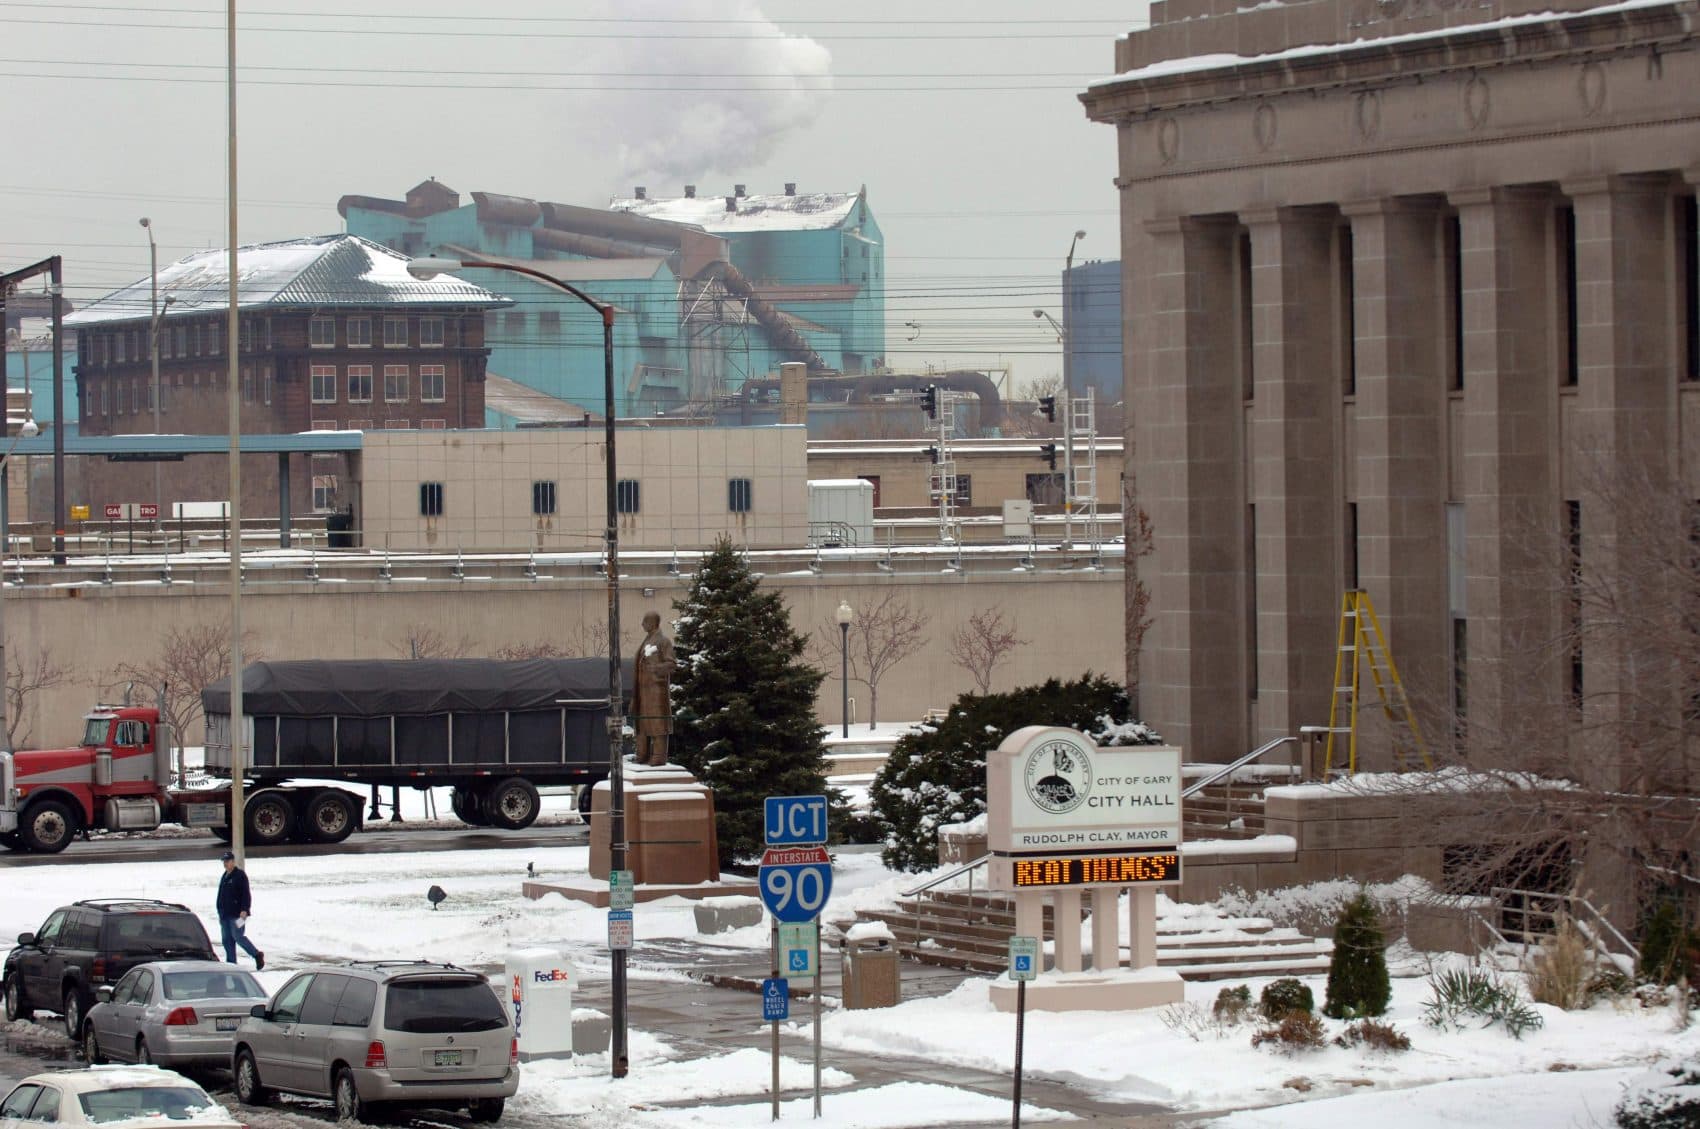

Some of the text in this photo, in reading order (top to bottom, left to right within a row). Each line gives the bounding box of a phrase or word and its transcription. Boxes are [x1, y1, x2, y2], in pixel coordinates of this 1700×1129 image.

[1097, 775, 1172, 786] CITY OF GARY
[1088, 794, 1175, 808] CITY HALL
[768, 802, 824, 838] JCT
[1023, 830, 1168, 845] RUDOLPH CLAY, MAYOR
[769, 851, 821, 864] INTERSTATE
[1016, 859, 1073, 885] REAT
[767, 867, 824, 912] 90
[534, 968, 568, 983] FedEx
[512, 975, 522, 1038] FedEx
